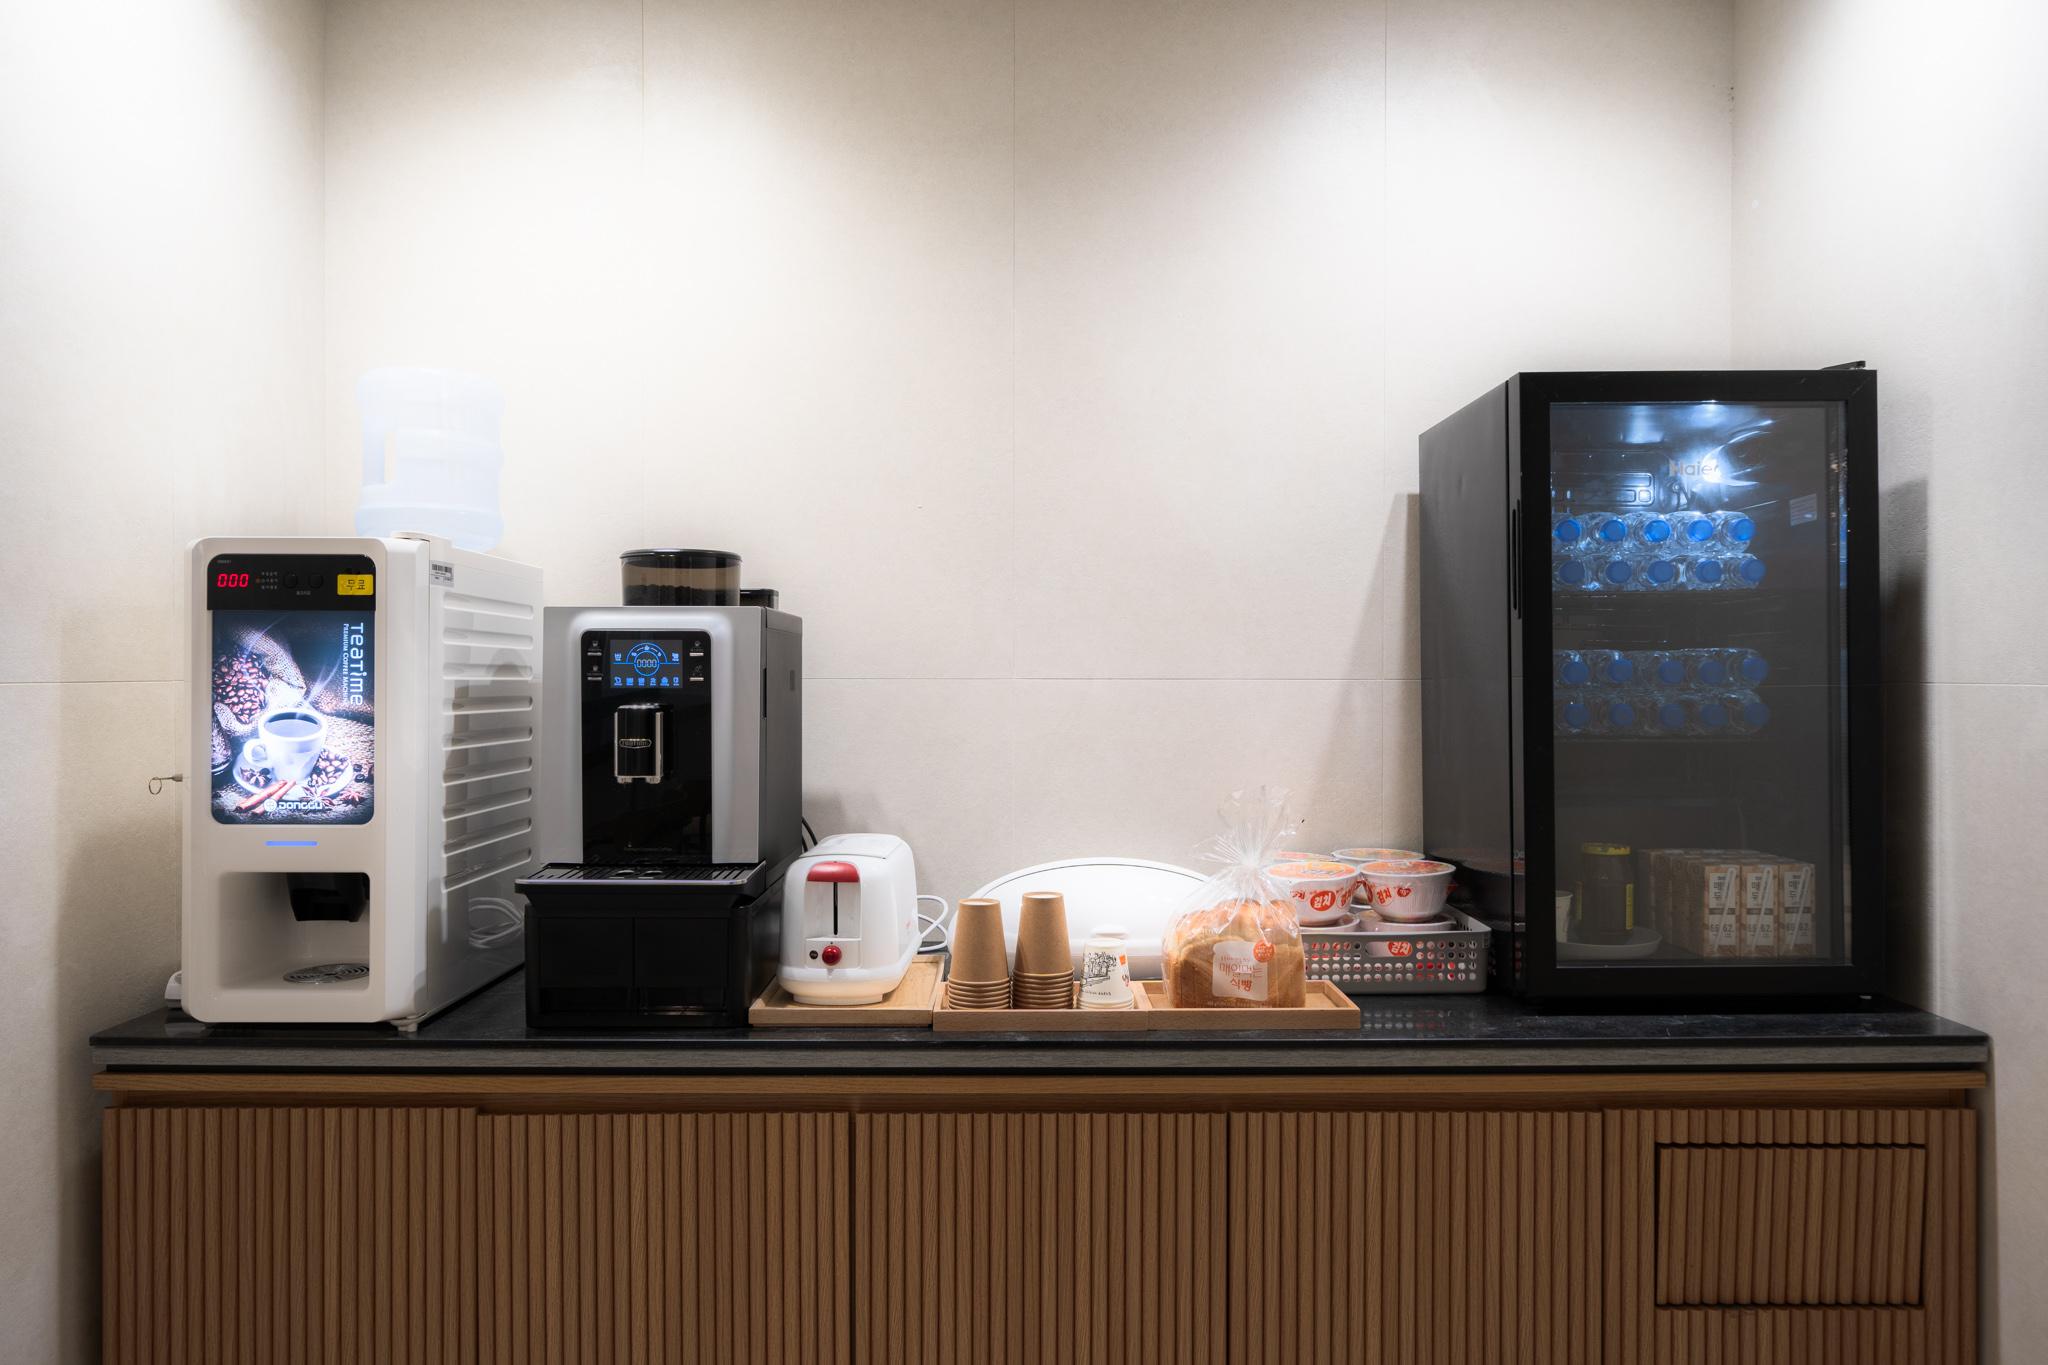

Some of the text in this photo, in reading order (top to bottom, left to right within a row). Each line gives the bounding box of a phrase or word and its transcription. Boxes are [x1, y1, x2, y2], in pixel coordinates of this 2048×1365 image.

[217, 573, 250, 588] 000
[345, 579, 366, 591] 무료
[636, 659, 657, 668] 0000
[1314, 892, 1332, 909] 김치
[1376, 887, 1393, 905] 김치
[1230, 978, 1253, 993] 식빵
